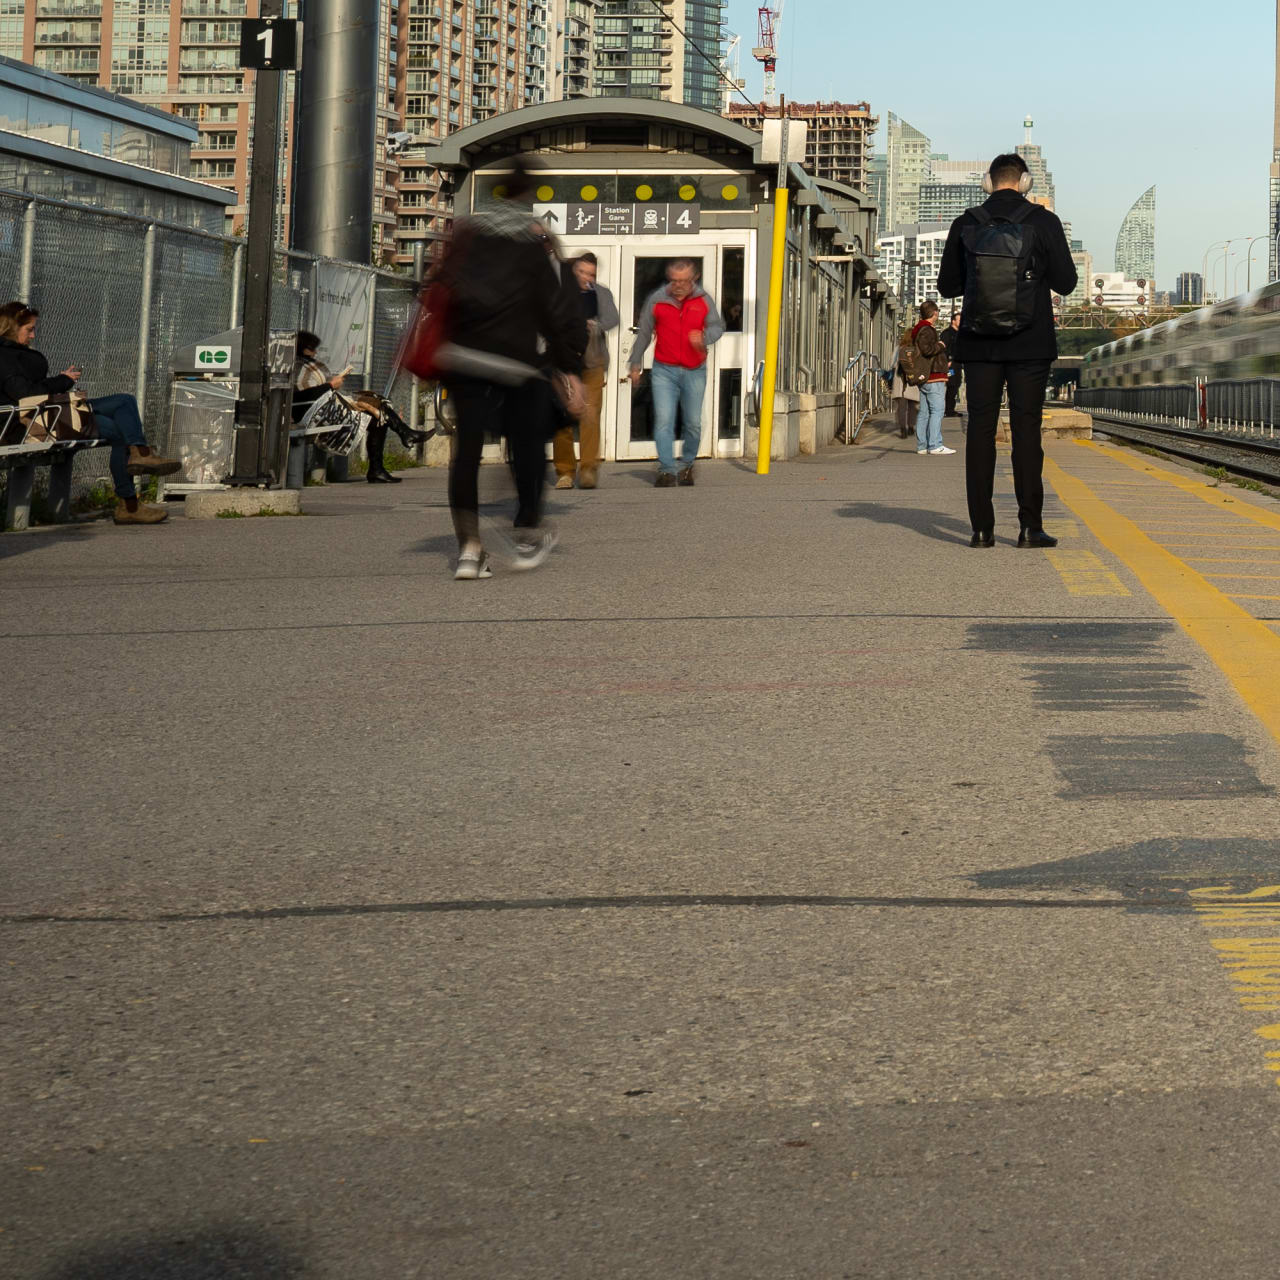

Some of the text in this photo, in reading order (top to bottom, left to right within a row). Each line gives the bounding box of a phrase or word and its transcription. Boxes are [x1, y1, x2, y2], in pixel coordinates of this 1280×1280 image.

[256, 28, 273, 59] 1
[759, 180, 769, 199] 1
[676, 209, 693, 229] 4
[199, 350, 228, 364] GO
